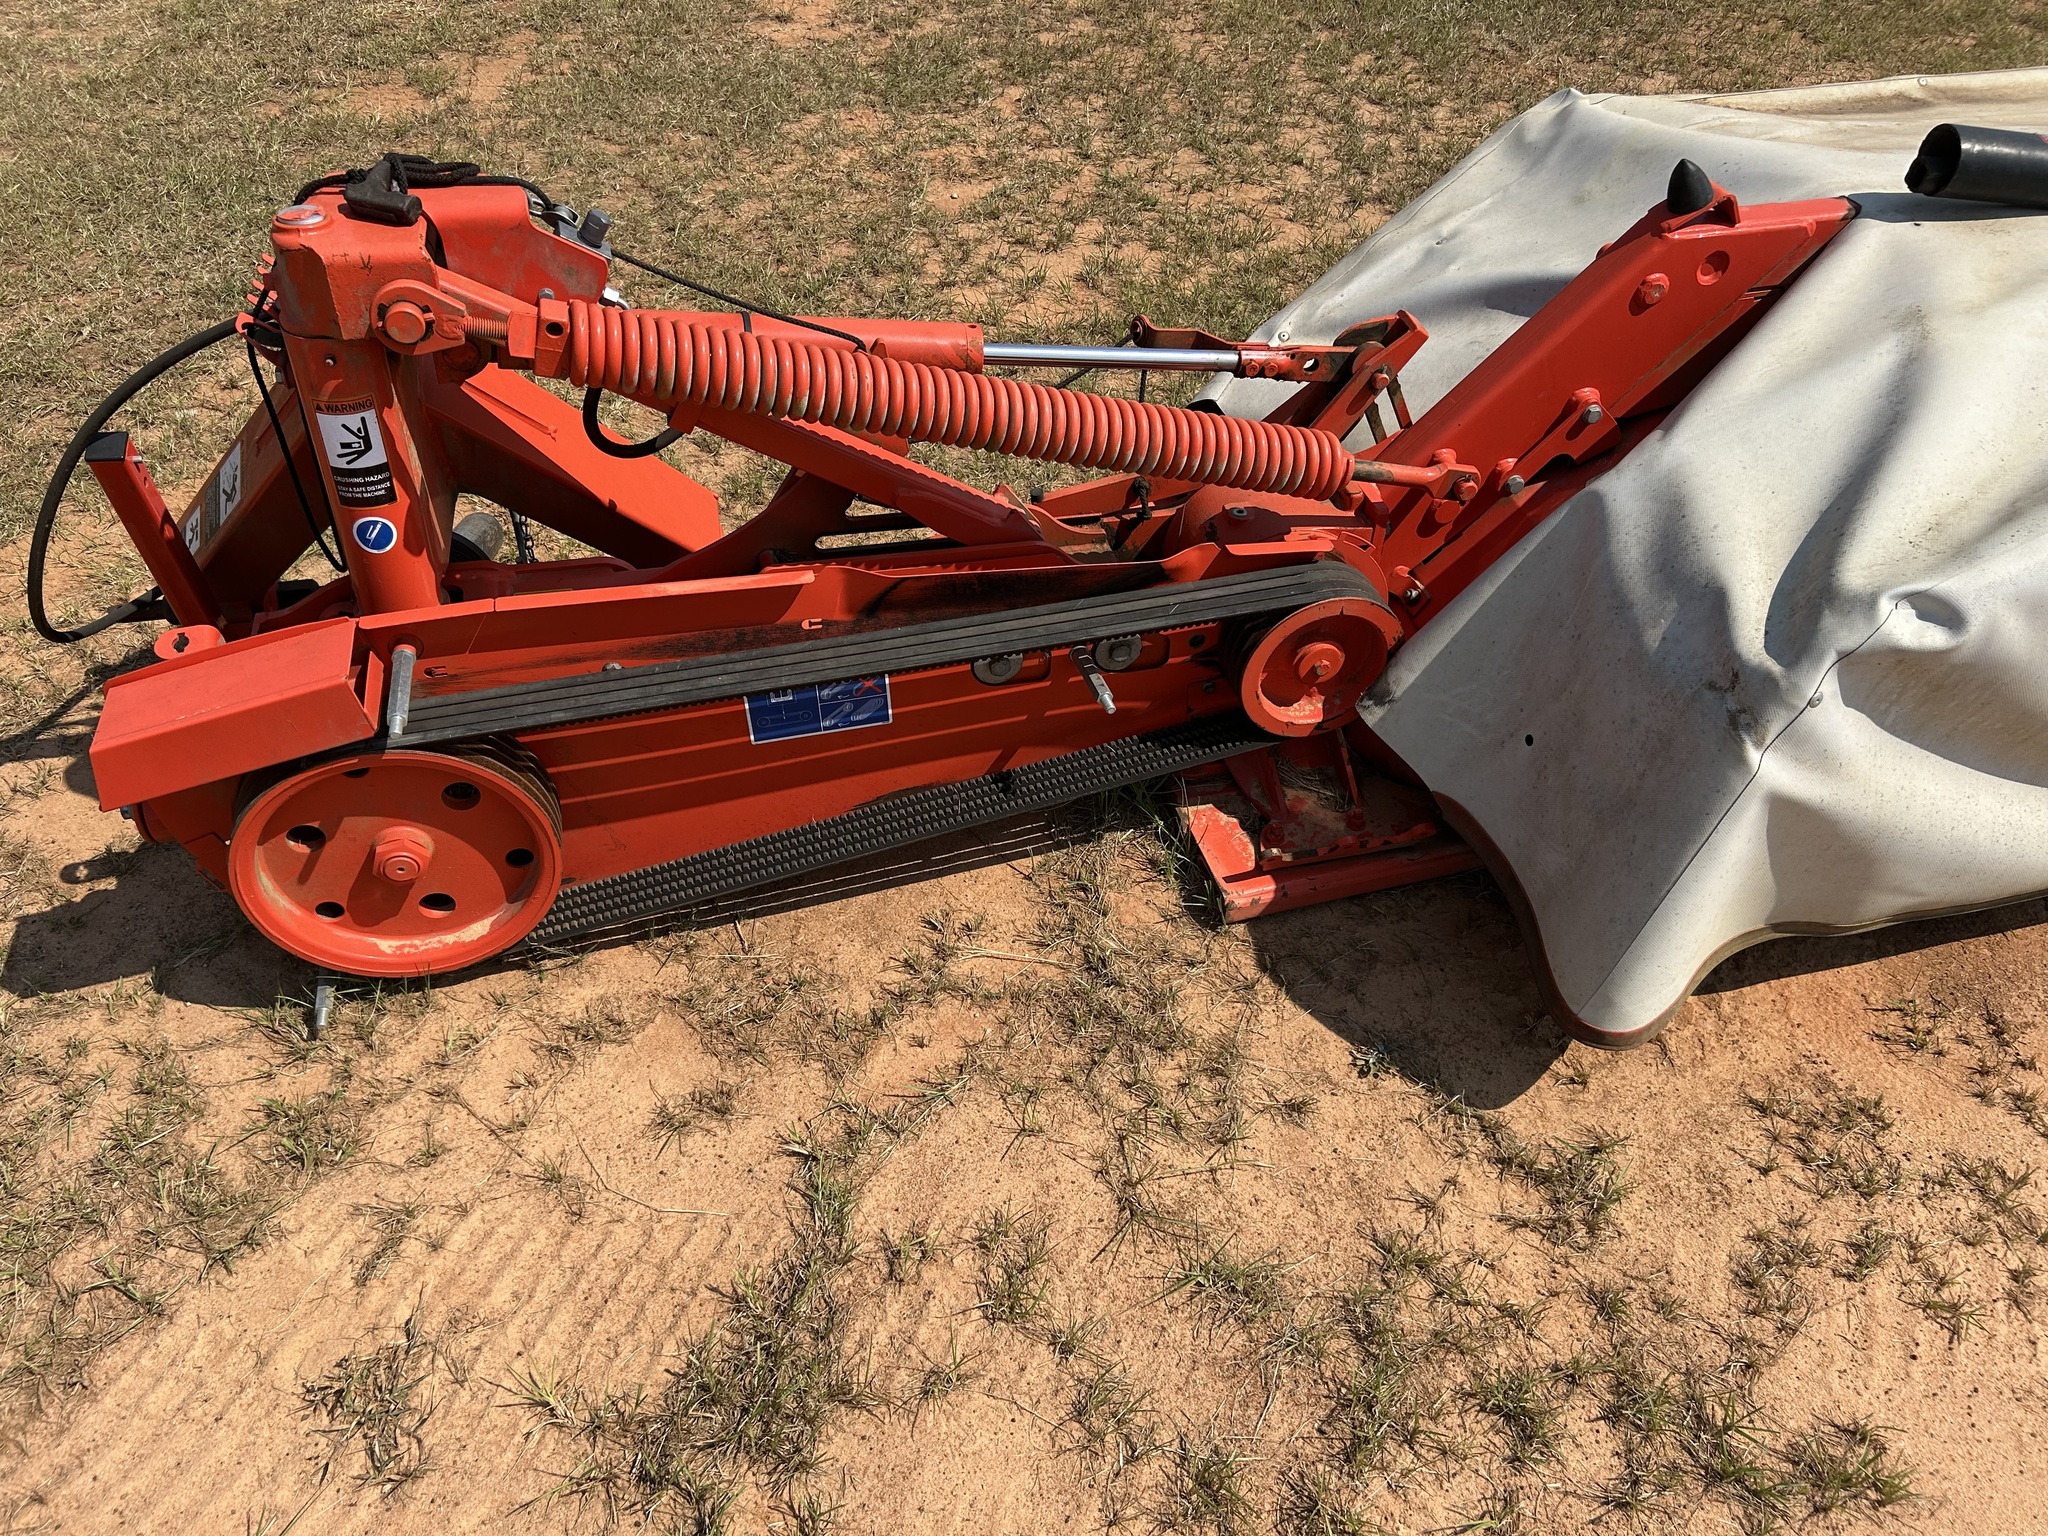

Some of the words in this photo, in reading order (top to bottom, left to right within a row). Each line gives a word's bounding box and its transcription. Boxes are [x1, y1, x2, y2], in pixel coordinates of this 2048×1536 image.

[324, 398, 373, 413] WARNING
[334, 475, 365, 483] CRUSHING
[365, 471, 390, 482] HAZARD
[366, 481, 391, 491] DISTANCE
[363, 489, 387, 498] MACHINE.
